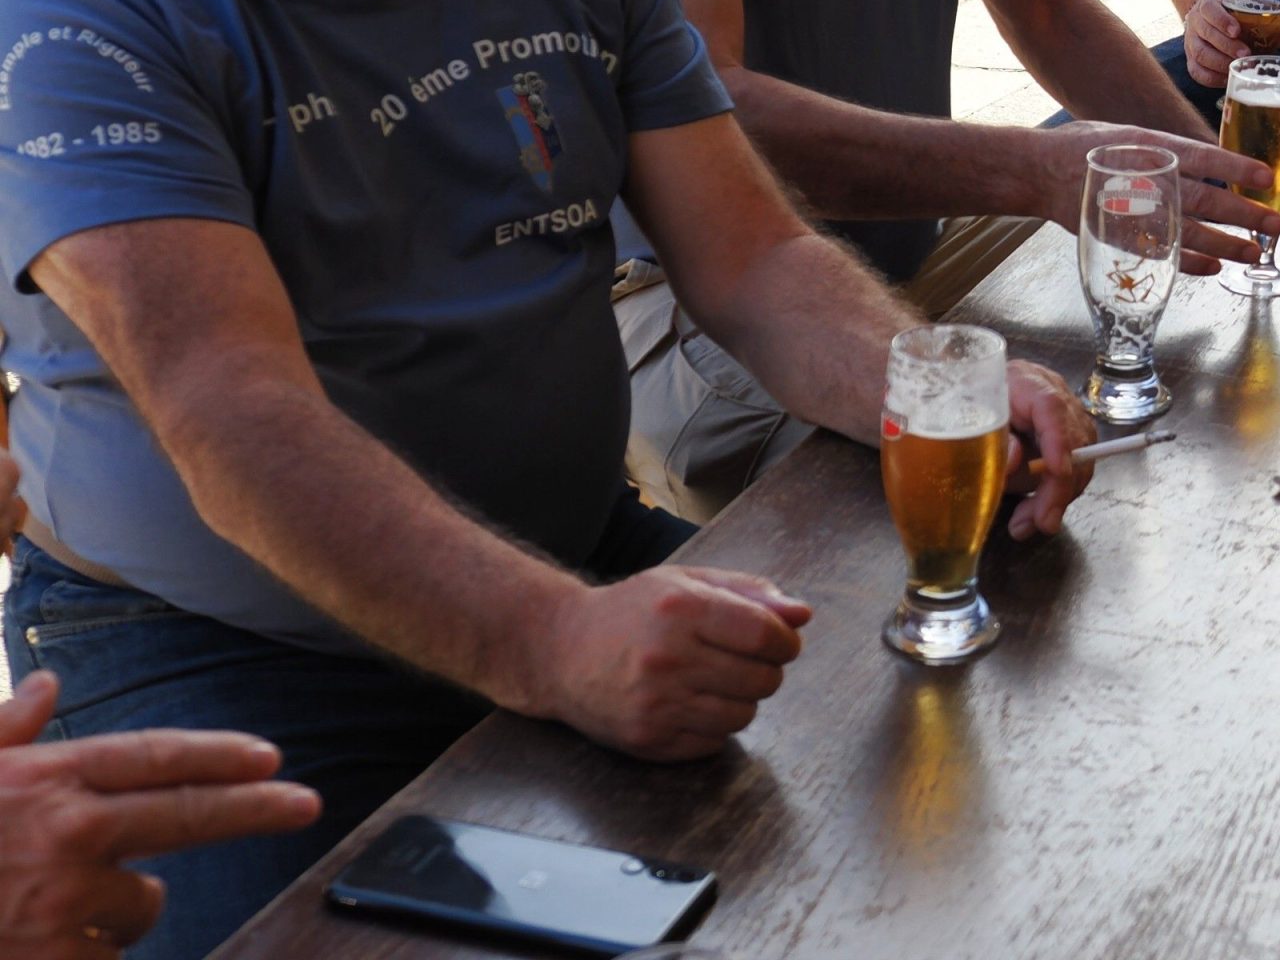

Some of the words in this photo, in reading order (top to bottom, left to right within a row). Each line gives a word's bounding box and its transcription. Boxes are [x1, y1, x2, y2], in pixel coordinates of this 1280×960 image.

[48, 26, 72, 41] et
[76, 28, 154, 92] Rigueur
[91, 121, 162, 145] 1985
[370, 94, 408, 137] 20
[495, 198, 598, 246] ENTSOA
